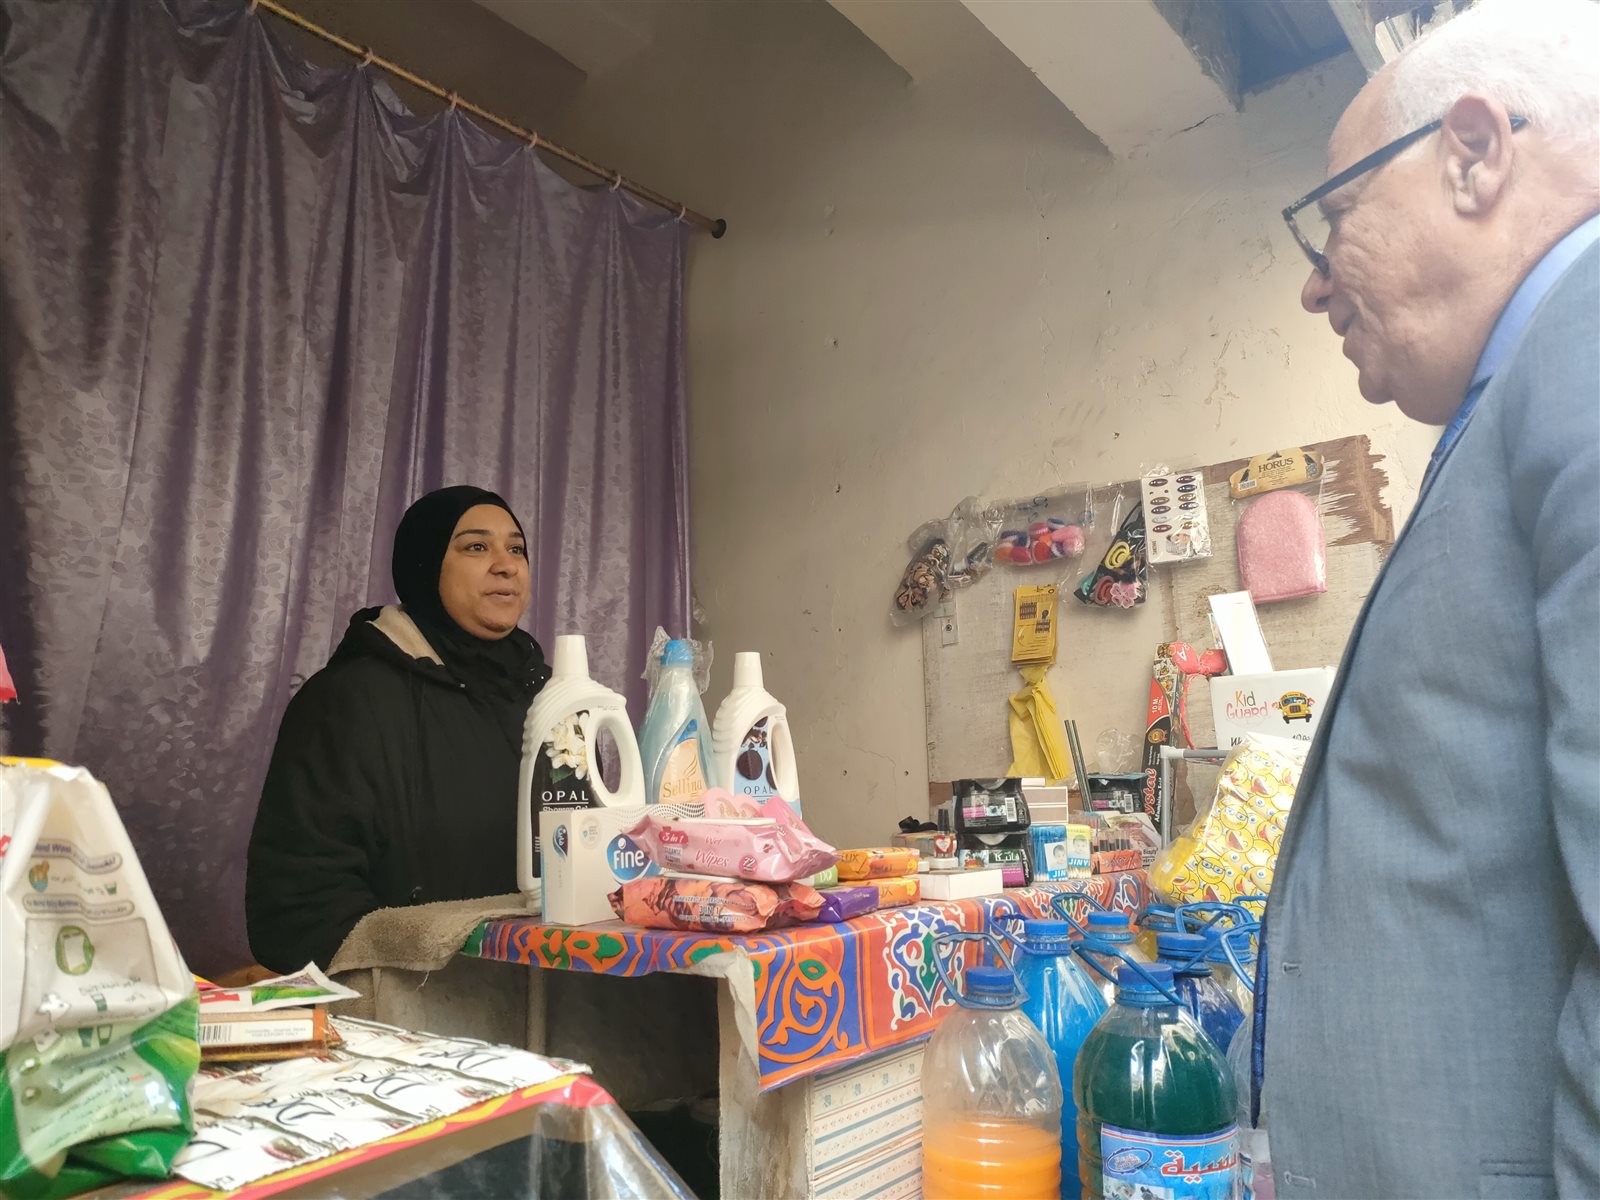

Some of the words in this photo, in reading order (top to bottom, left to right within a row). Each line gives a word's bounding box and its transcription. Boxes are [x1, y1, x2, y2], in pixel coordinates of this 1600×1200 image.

[1258, 457, 1294, 473] HORUS
[1235, 690, 1256, 707] Kid
[1226, 702, 1269, 719] Guard
[541, 790, 589, 802] OPAL
[1143, 767, 1157, 816] ystal
[695, 849, 729, 867] Wipes
